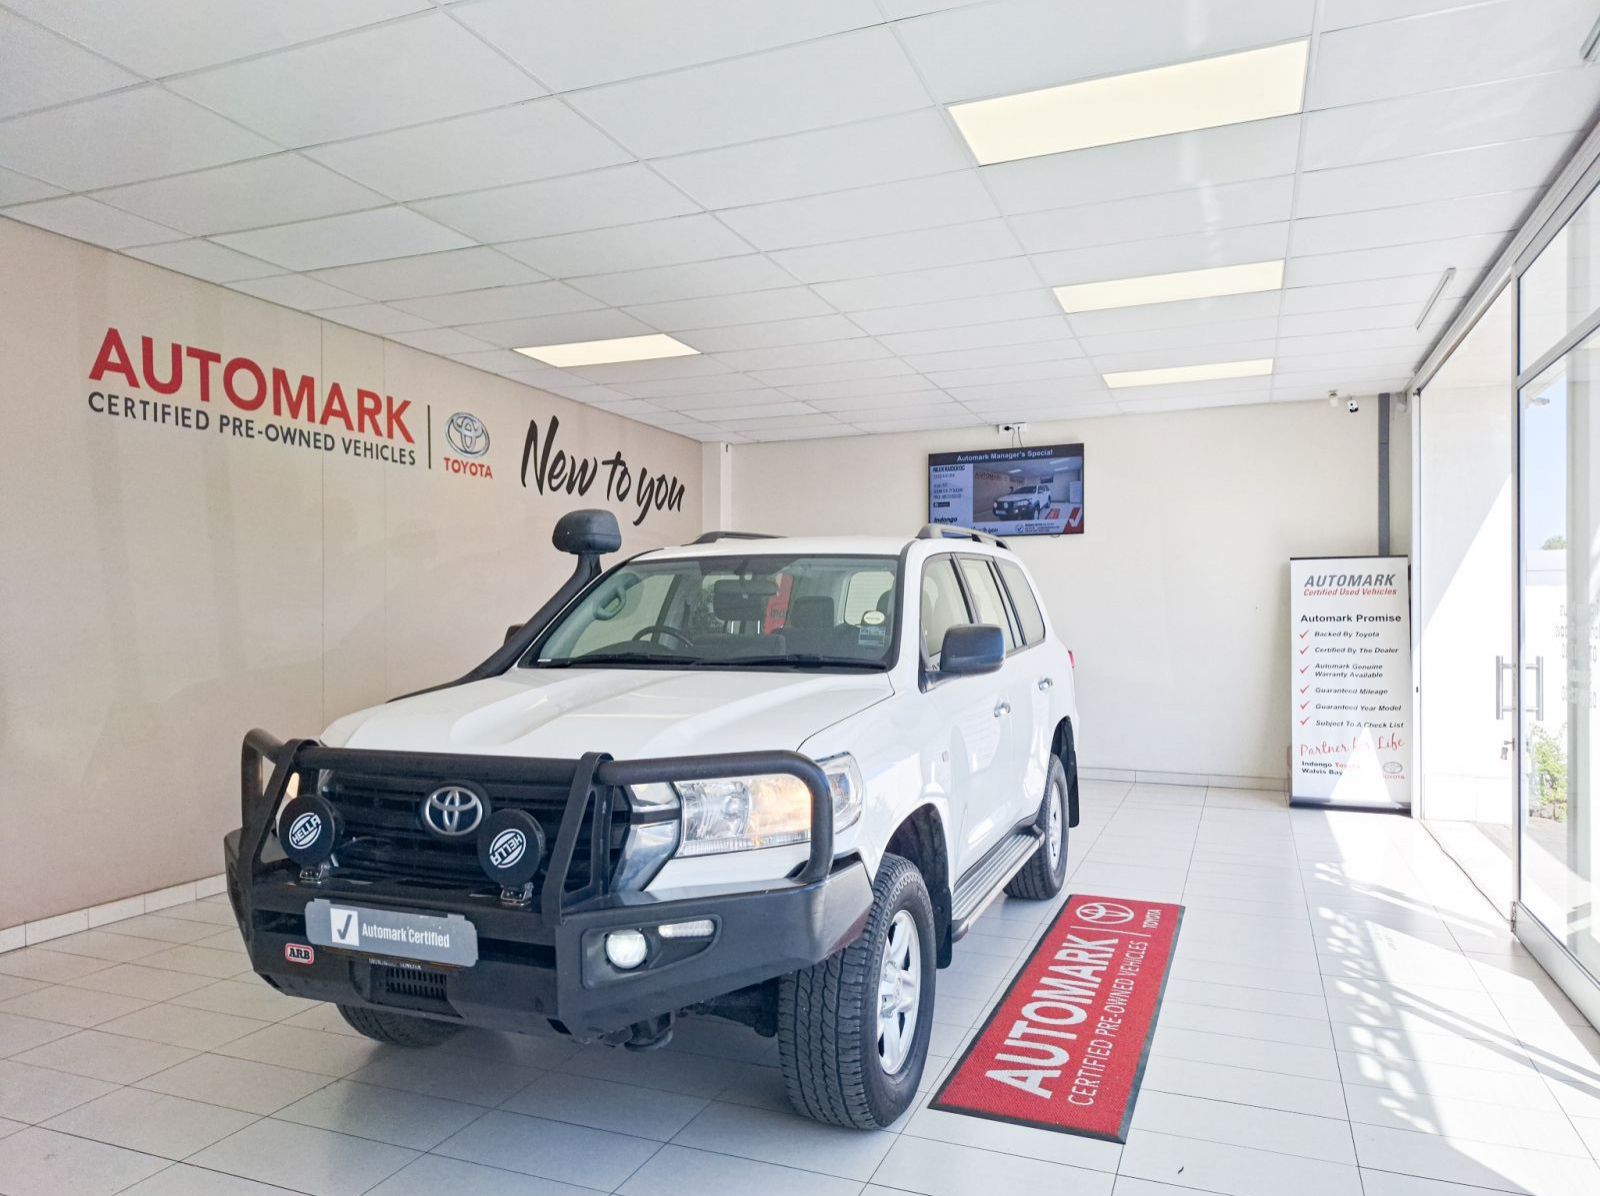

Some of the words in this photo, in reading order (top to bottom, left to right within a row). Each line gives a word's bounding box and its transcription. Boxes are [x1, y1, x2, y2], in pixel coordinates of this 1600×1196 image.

[88, 327, 415, 443] AUTOMARK
[88, 391, 210, 431] CERTIFIED
[218, 414, 335, 451] PRE-OWNED
[341, 438, 416, 466] VEHICLES
[957, 453, 989, 462] Automark
[990, 451, 1026, 460] Manager's
[1027, 449, 1053, 458] Special
[443, 456, 493, 480] TOYOTA
[520, 415, 597, 498] New
[601, 450, 633, 502] to
[633, 474, 686, 526] you
[1303, 588, 1338, 596] Certified
[1339, 588, 1360, 596] Used
[1362, 587, 1397, 596] Vehicles
[1304, 574, 1396, 587] AUTOMARK
[1300, 614, 1353, 623] Automark
[1356, 613, 1402, 623] Promise
[1359, 688, 1388, 696] Mileage
[1315, 720, 1344, 728] Subject
[1300, 740, 1348, 757] Partner
[291, 814, 321, 844] HELLA
[490, 834, 523, 866] HELLA
[1142, 909, 1162, 929] TOYOTA
[362, 922, 407, 942] Automark
[408, 928, 450, 948] Certified
[288, 947, 310, 960] ARB
[985, 934, 1119, 1099] AUTOMARK
[1068, 1039, 1113, 1106] CERTIFIED
[1096, 975, 1134, 1037] PRE-OWNED
[1120, 940, 1149, 976] VEHICLES
